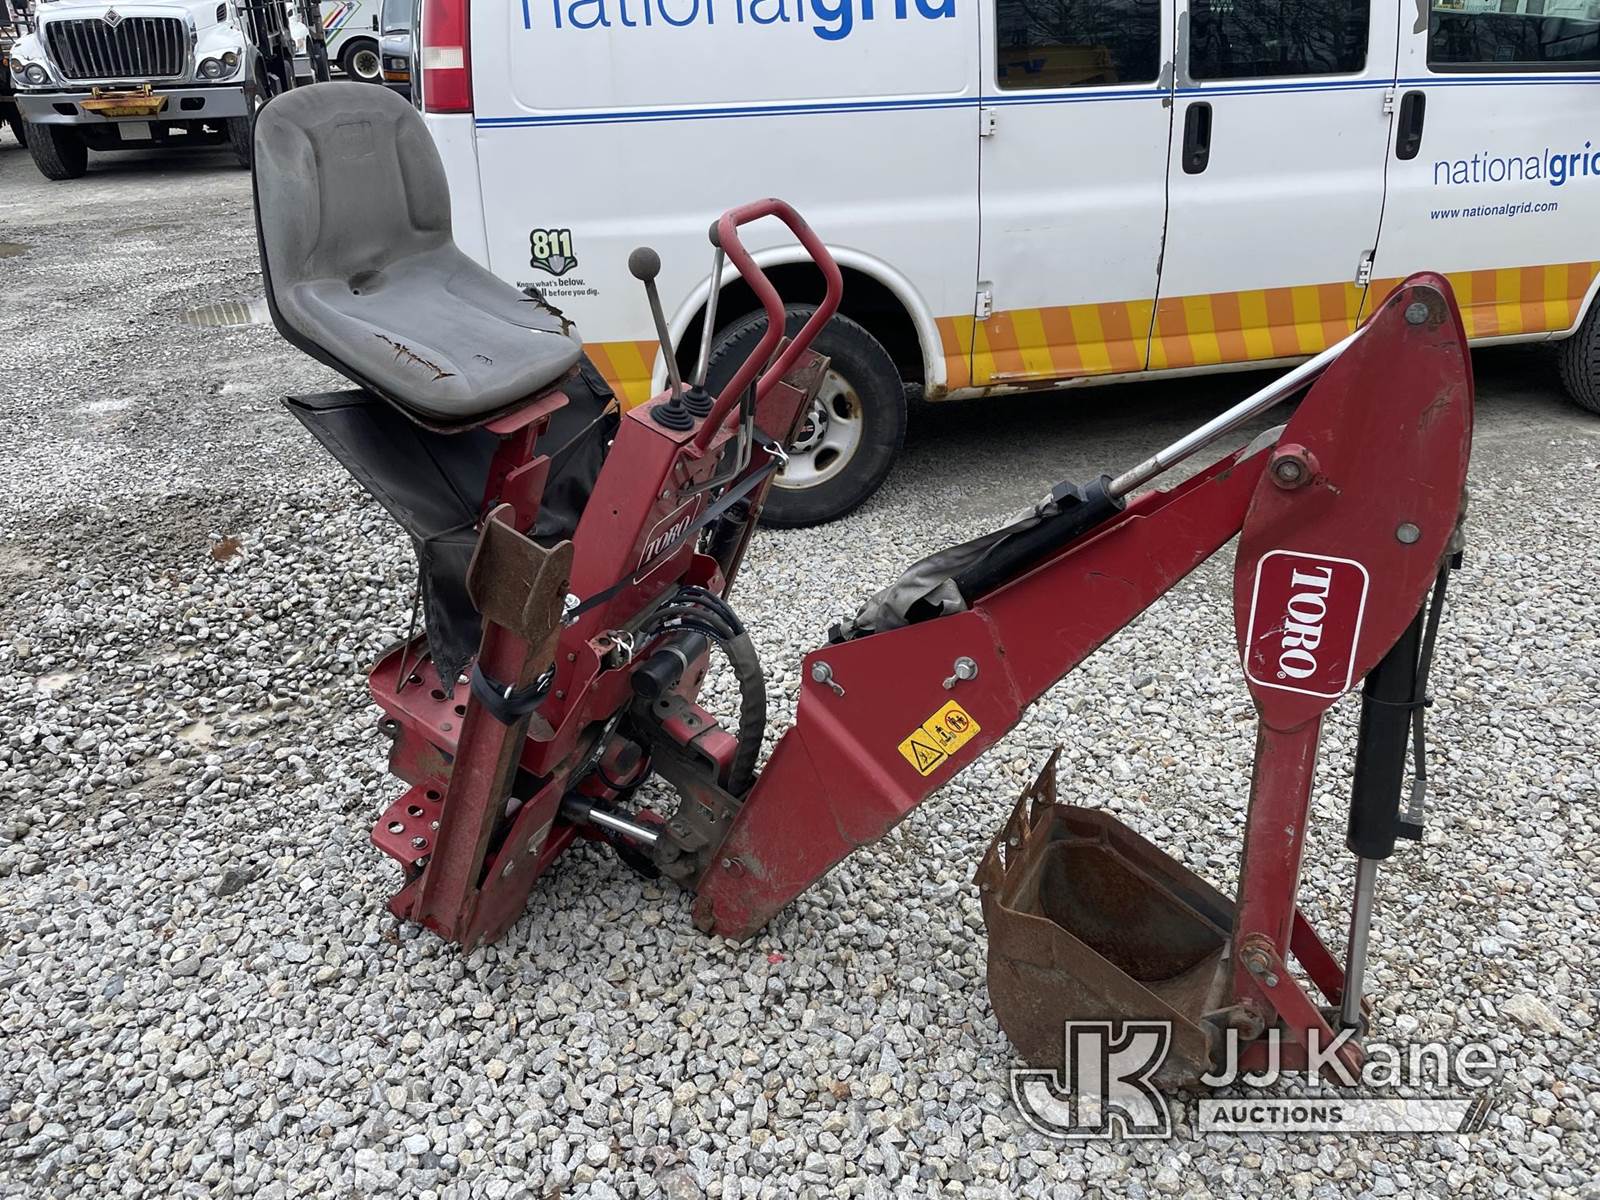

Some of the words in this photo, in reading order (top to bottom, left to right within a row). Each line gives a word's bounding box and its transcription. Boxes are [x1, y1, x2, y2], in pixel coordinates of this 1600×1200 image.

[531, 229, 573, 260] 811
[548, 288, 572, 297] before
[573, 288, 586, 297] you
[586, 288, 600, 296] dig.
[558, 278, 585, 286] below.
[645, 515, 691, 563] TORO
[1279, 566, 1333, 679] TORO
